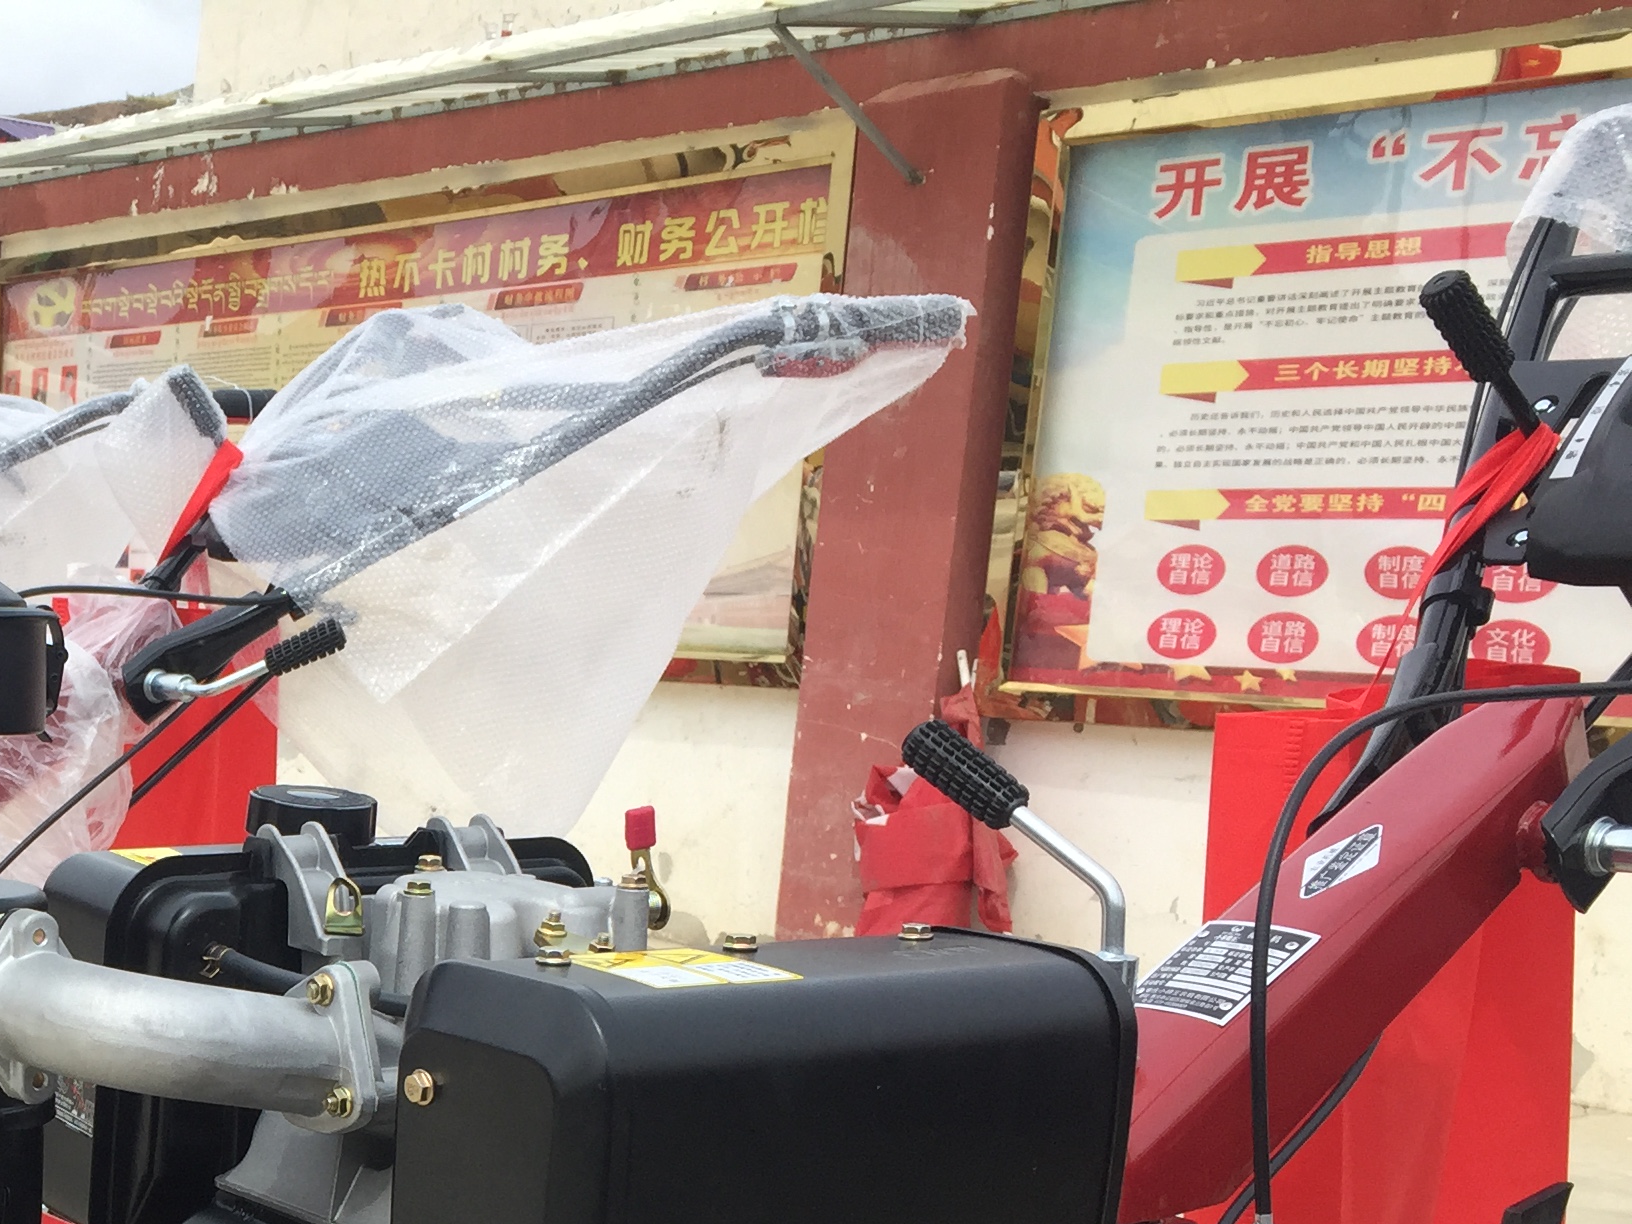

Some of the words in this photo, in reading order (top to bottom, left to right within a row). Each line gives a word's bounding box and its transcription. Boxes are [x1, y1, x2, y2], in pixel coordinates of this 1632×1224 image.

[358, 196, 827, 299] 热不卡村村务、财务公开栏
[1306, 236, 1423, 264] 指导思想
[1169, 552, 1214, 571] 理论
[1270, 553, 1315, 571] 道路
[1378, 555, 1425, 572] 制度
[1169, 569, 1211, 586] 自信
[1270, 569, 1313, 588] 自信
[1378, 572, 1422, 589] 自信
[1492, 572, 1542, 592] 自信
[1159, 617, 1204, 635] 理论
[1261, 619, 1306, 637] 道路
[1159, 632, 1200, 650] 自信
[1260, 635, 1304, 653] 自信
[1486, 627, 1536, 647] 文化
[1486, 645, 1535, 664] 自信
